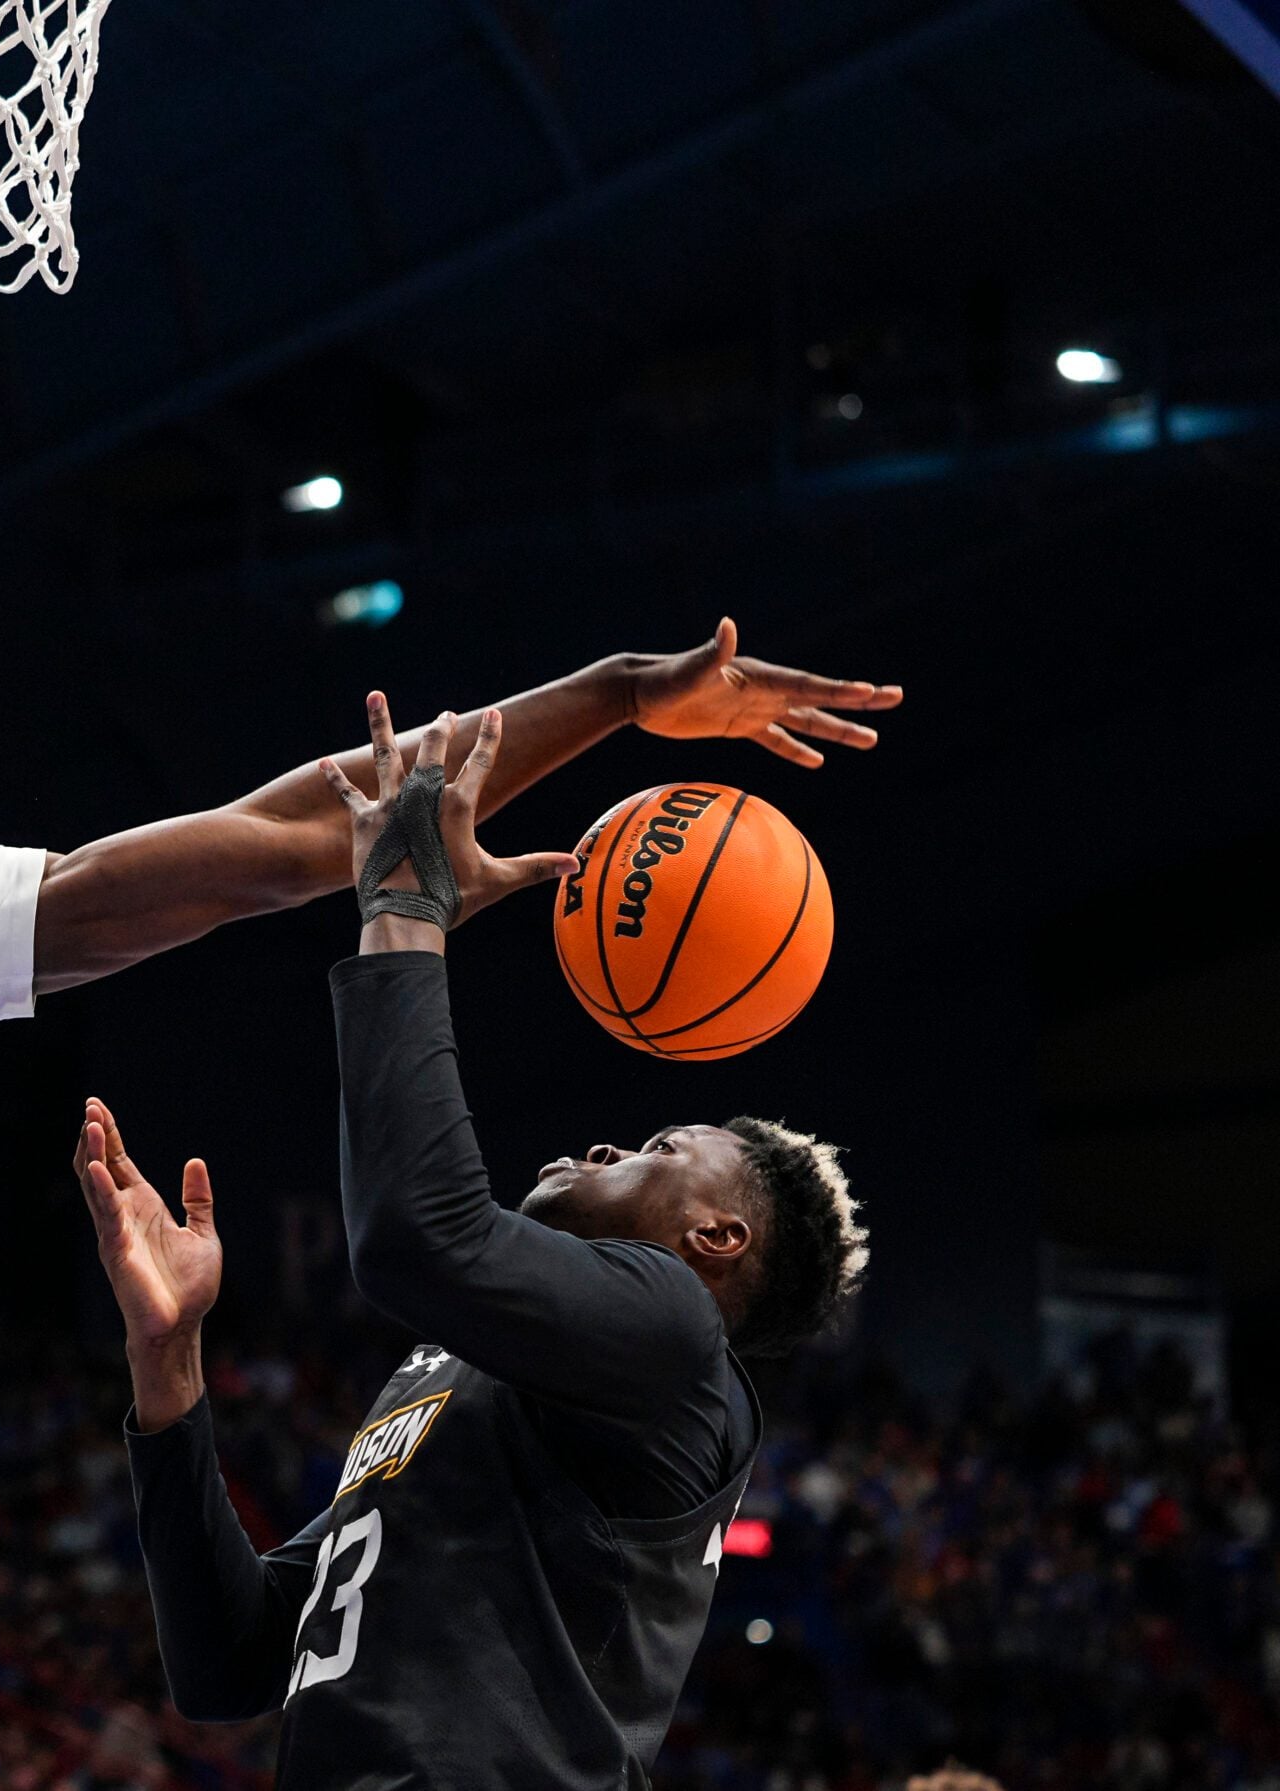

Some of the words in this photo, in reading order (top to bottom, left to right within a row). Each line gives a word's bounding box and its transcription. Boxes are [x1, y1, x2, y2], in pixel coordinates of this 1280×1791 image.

[631, 820, 646, 841] EVO
[614, 788, 721, 939] Wilson
[619, 844, 633, 869] NXT
